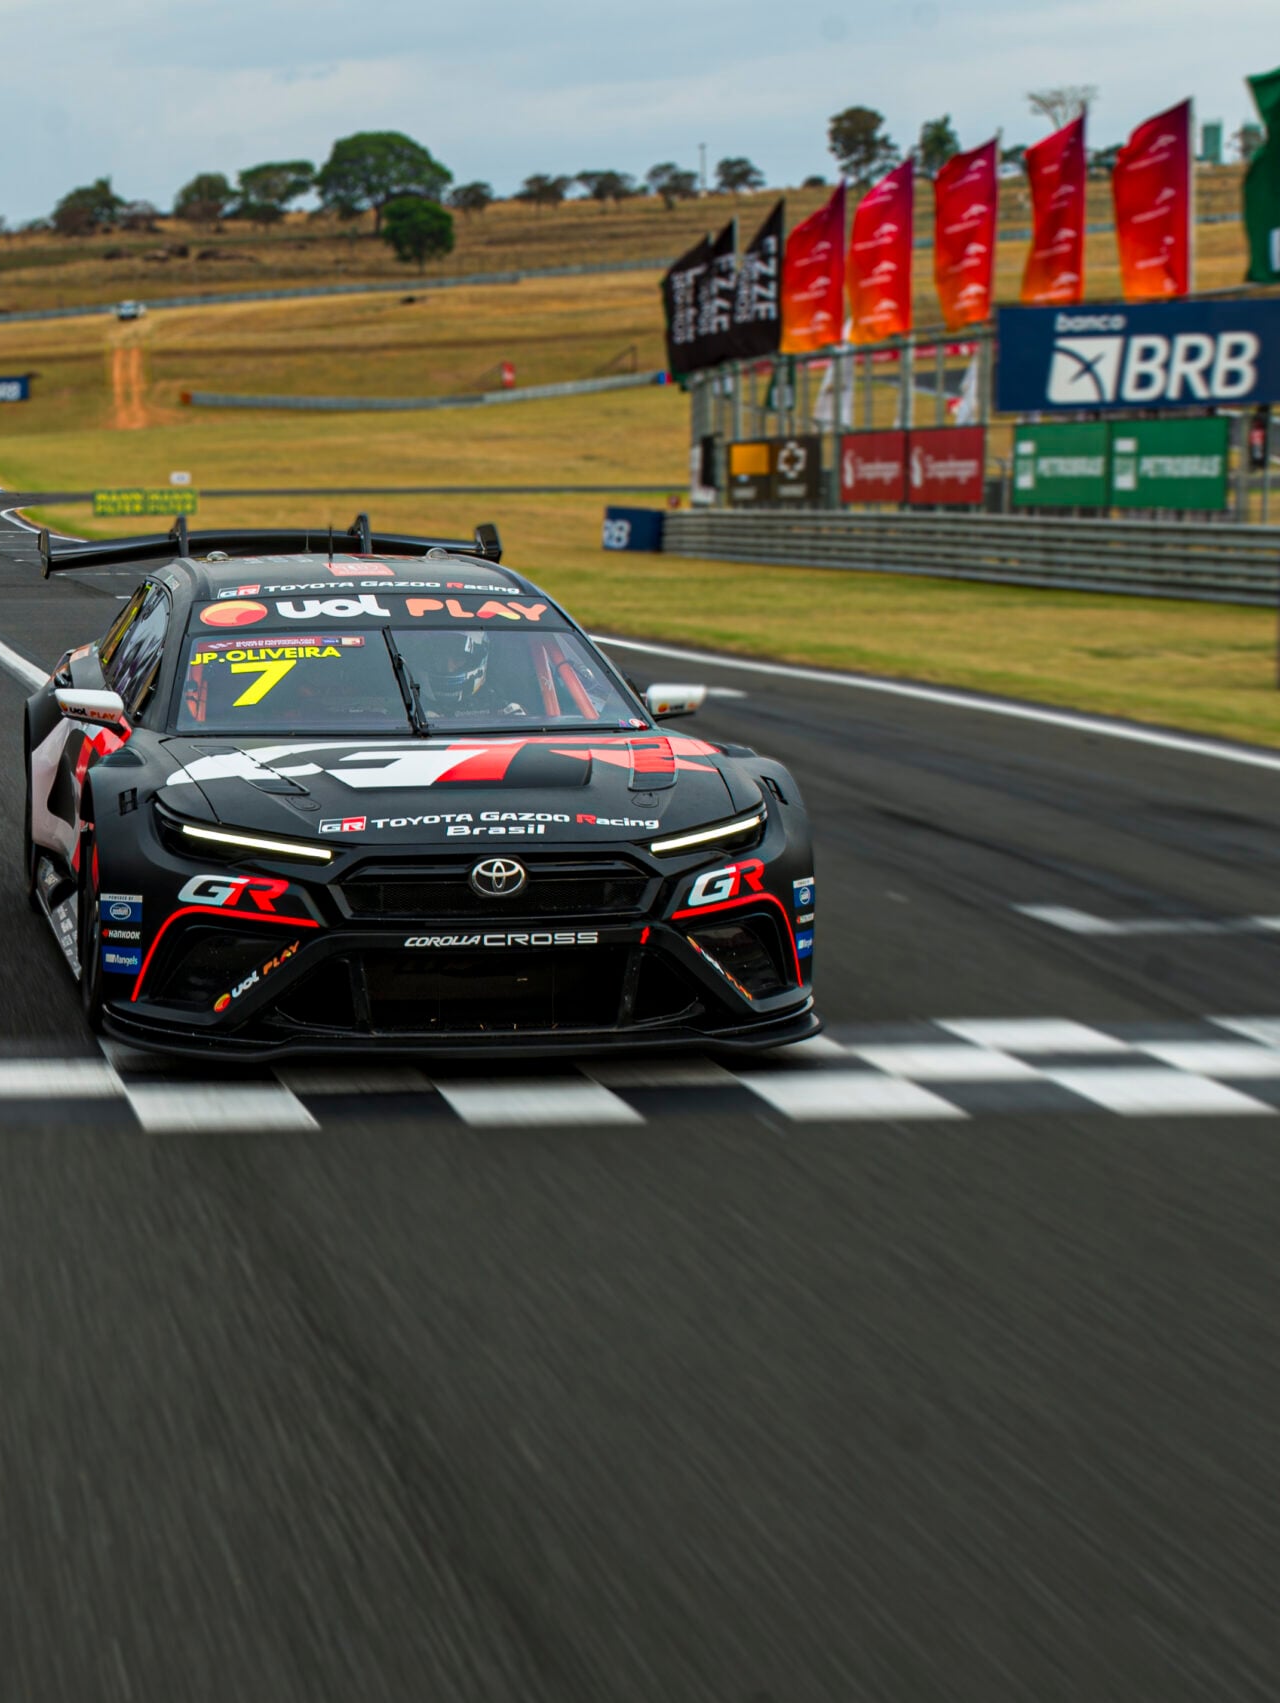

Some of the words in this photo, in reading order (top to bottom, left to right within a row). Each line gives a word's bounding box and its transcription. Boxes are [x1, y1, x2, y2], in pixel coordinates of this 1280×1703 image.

[1054, 314, 1126, 332] banco
[1121, 331, 1260, 402] BRB
[263, 581, 354, 593] TOYOTA
[360, 580, 441, 588] GAZOO
[446, 582, 520, 594] Racing
[405, 598, 547, 621] PLAY
[190, 646, 342, 666] JP.OLIVEIRA
[230, 659, 297, 707] 7
[90, 710, 116, 720] PLAY
[321, 821, 365, 833] GR
[371, 813, 474, 829] TOYOTA
[480, 811, 570, 822] GAZOO
[576, 813, 660, 830] Racing
[446, 824, 546, 837] Brasil
[178, 874, 289, 912] GR
[688, 858, 764, 906] GR
[404, 935, 481, 948] COROLLA
[483, 932, 599, 946] CROSS
[262, 940, 300, 976] PLAY
